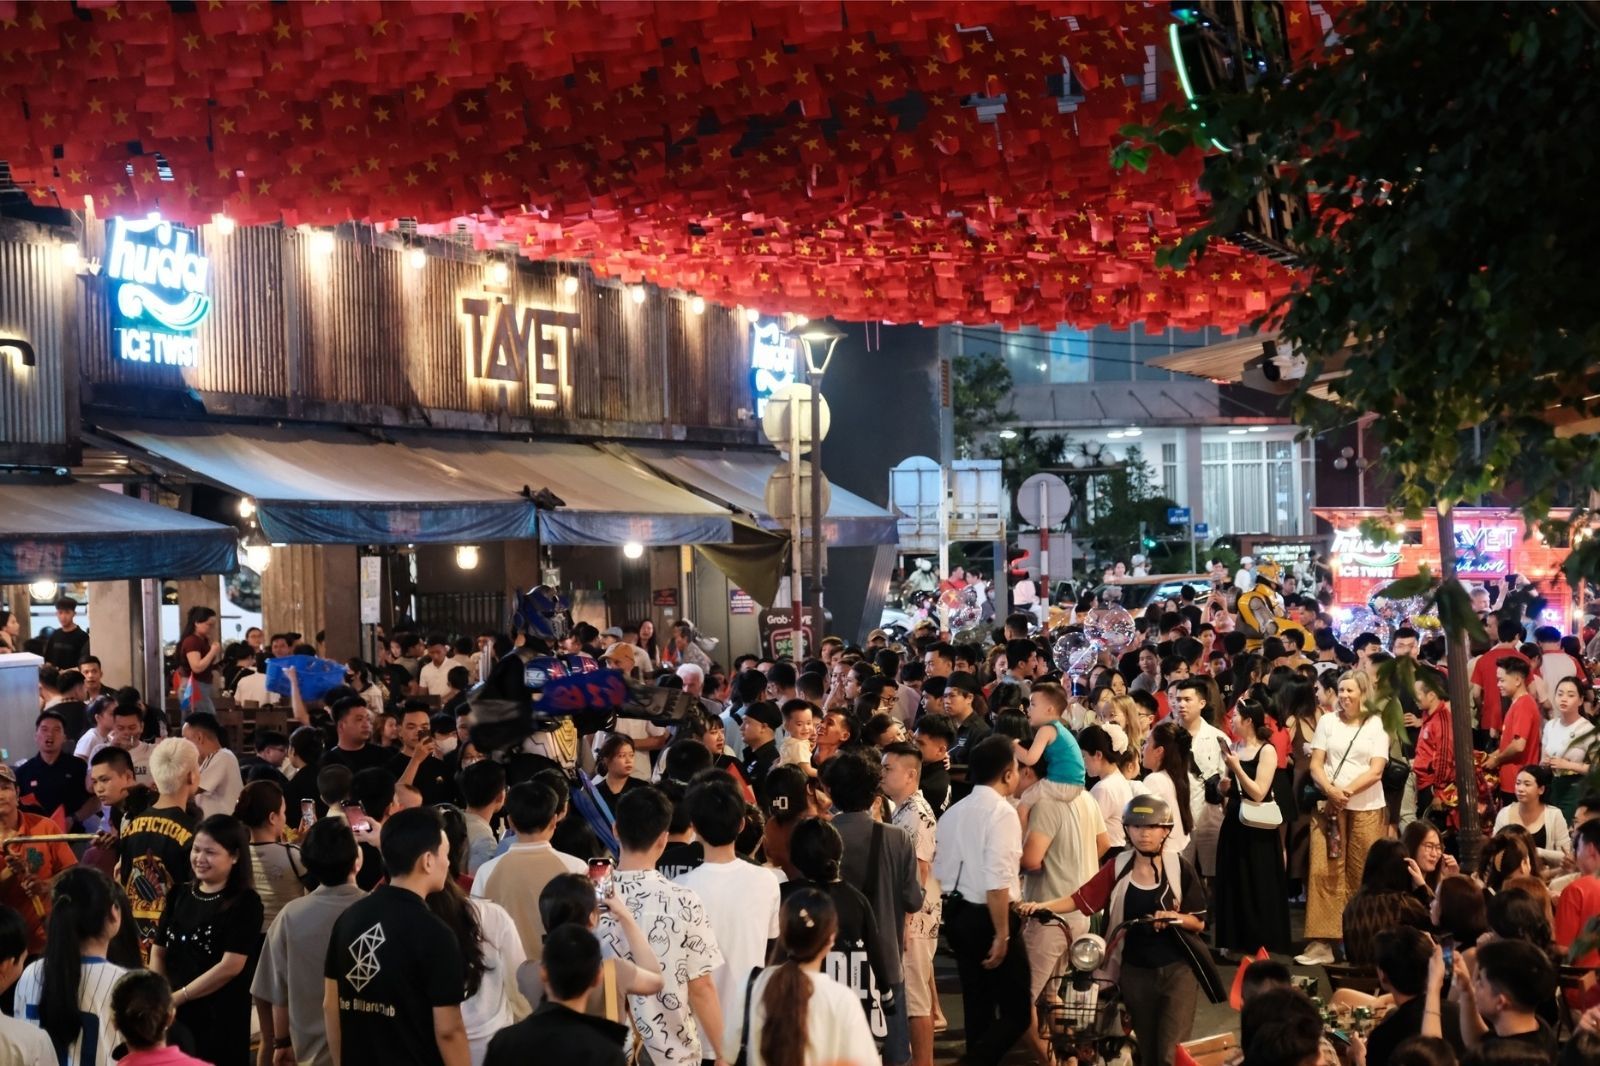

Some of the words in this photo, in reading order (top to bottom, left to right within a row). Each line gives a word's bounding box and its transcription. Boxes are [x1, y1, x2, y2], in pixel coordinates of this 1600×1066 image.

[108, 216, 208, 292] huda
[120, 327, 151, 362] ICE
[153, 331, 199, 367] TWIST
[767, 614, 788, 624] Grab
[339, 996, 350, 1010] he
